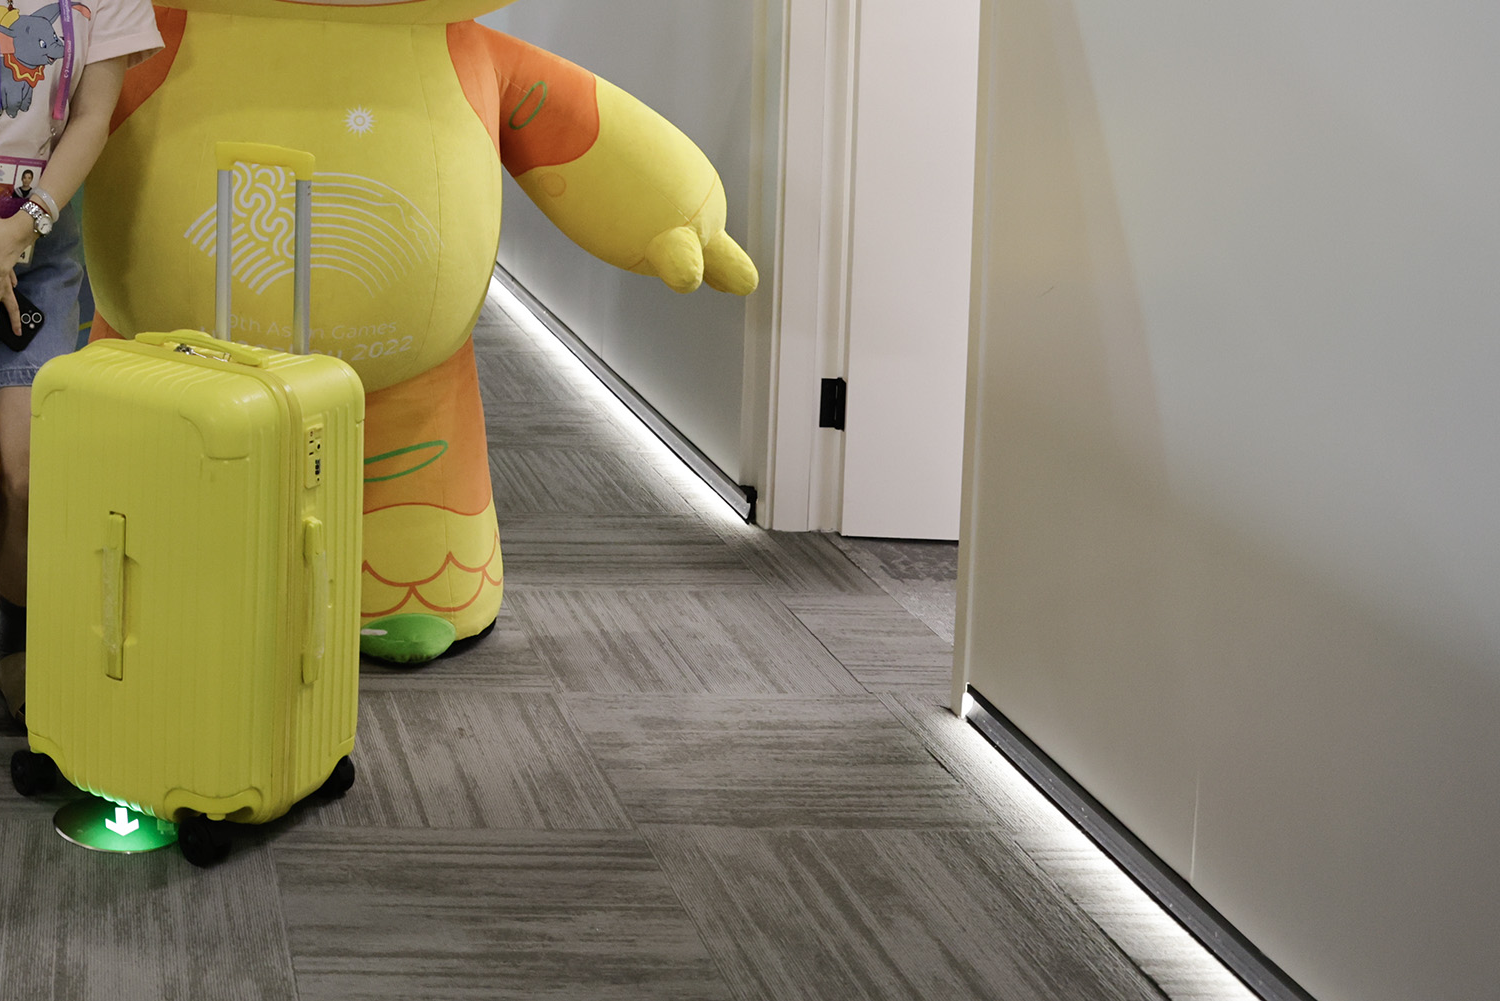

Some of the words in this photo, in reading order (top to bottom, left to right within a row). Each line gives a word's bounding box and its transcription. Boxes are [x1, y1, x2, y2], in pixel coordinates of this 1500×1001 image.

[266, 321, 325, 340] Asn
[331, 321, 398, 340] Games
[351, 335, 414, 362] 2022
